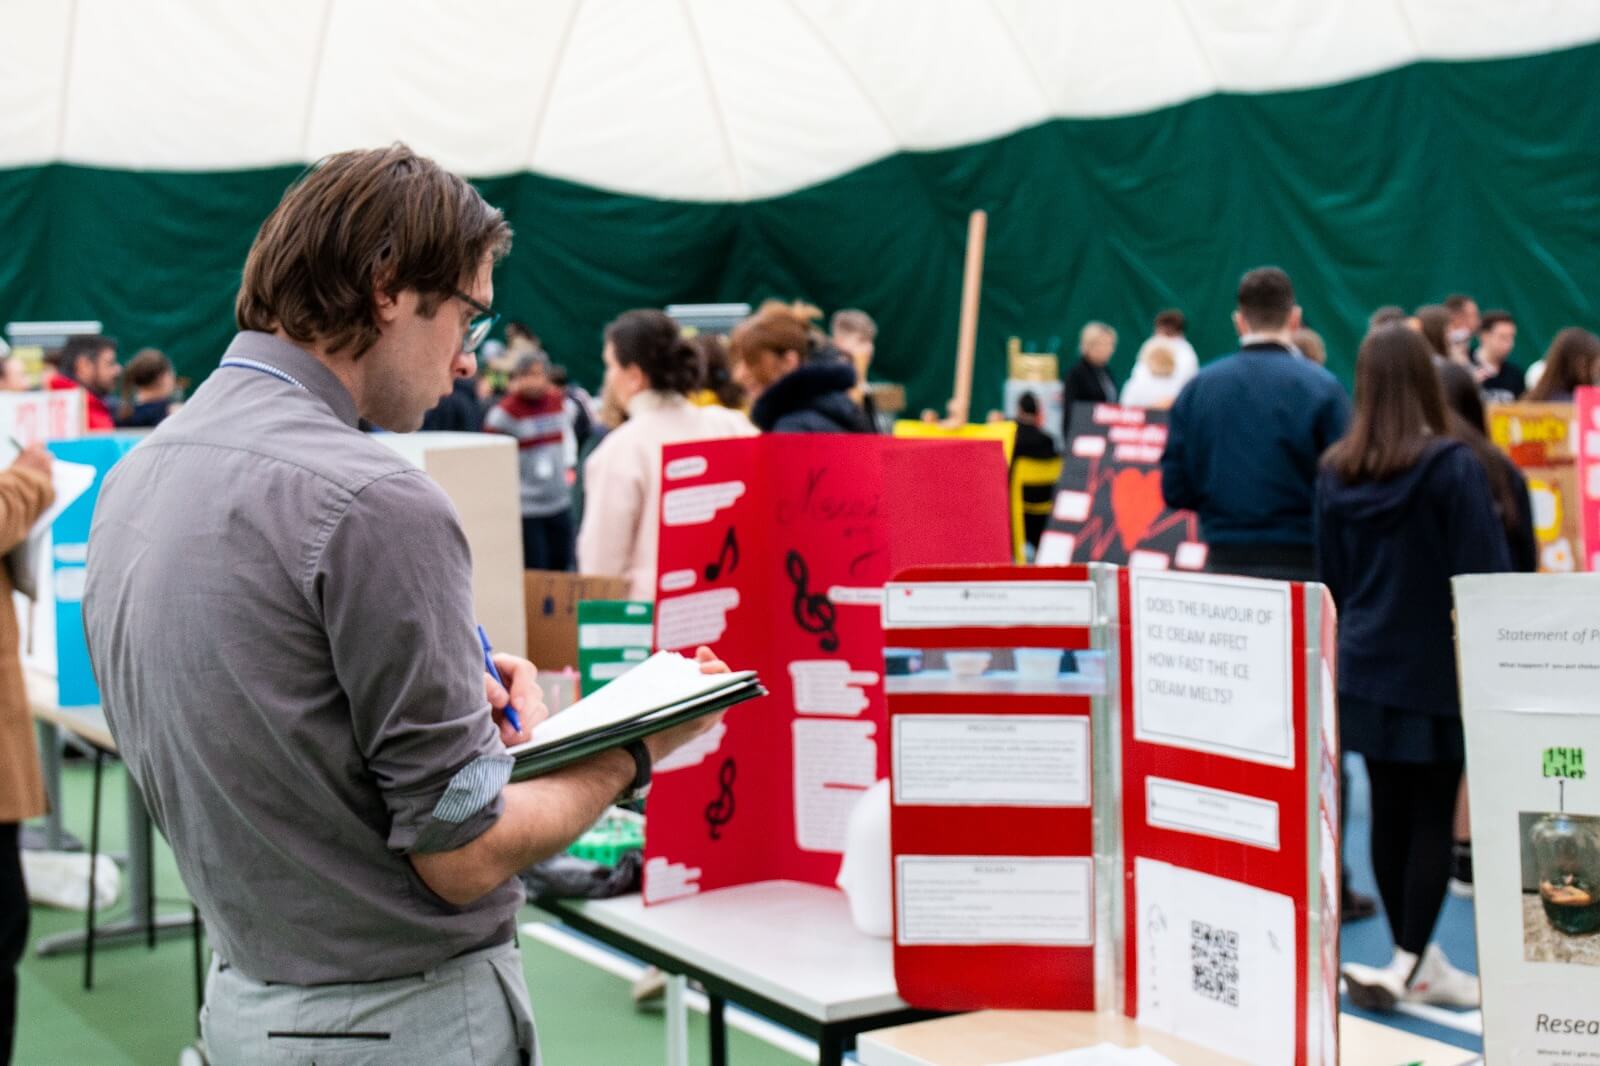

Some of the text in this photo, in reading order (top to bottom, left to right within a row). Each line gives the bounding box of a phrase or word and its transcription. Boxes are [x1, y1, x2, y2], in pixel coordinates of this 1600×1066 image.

[1146, 596, 1273, 625] DOES THE FLAVOUR OF
[1147, 624, 1248, 650] ICE CREAM AFFECT
[1496, 627, 1569, 641] Statement
[1572, 627, 1588, 645] of
[1147, 651, 1250, 680] HOW FAST THE ICE
[1147, 678, 1234, 705] CREAM MELTS?
[1548, 746, 1583, 765] 14H
[1543, 762, 1586, 778] Later
[1536, 1013, 1600, 1035] Resea
